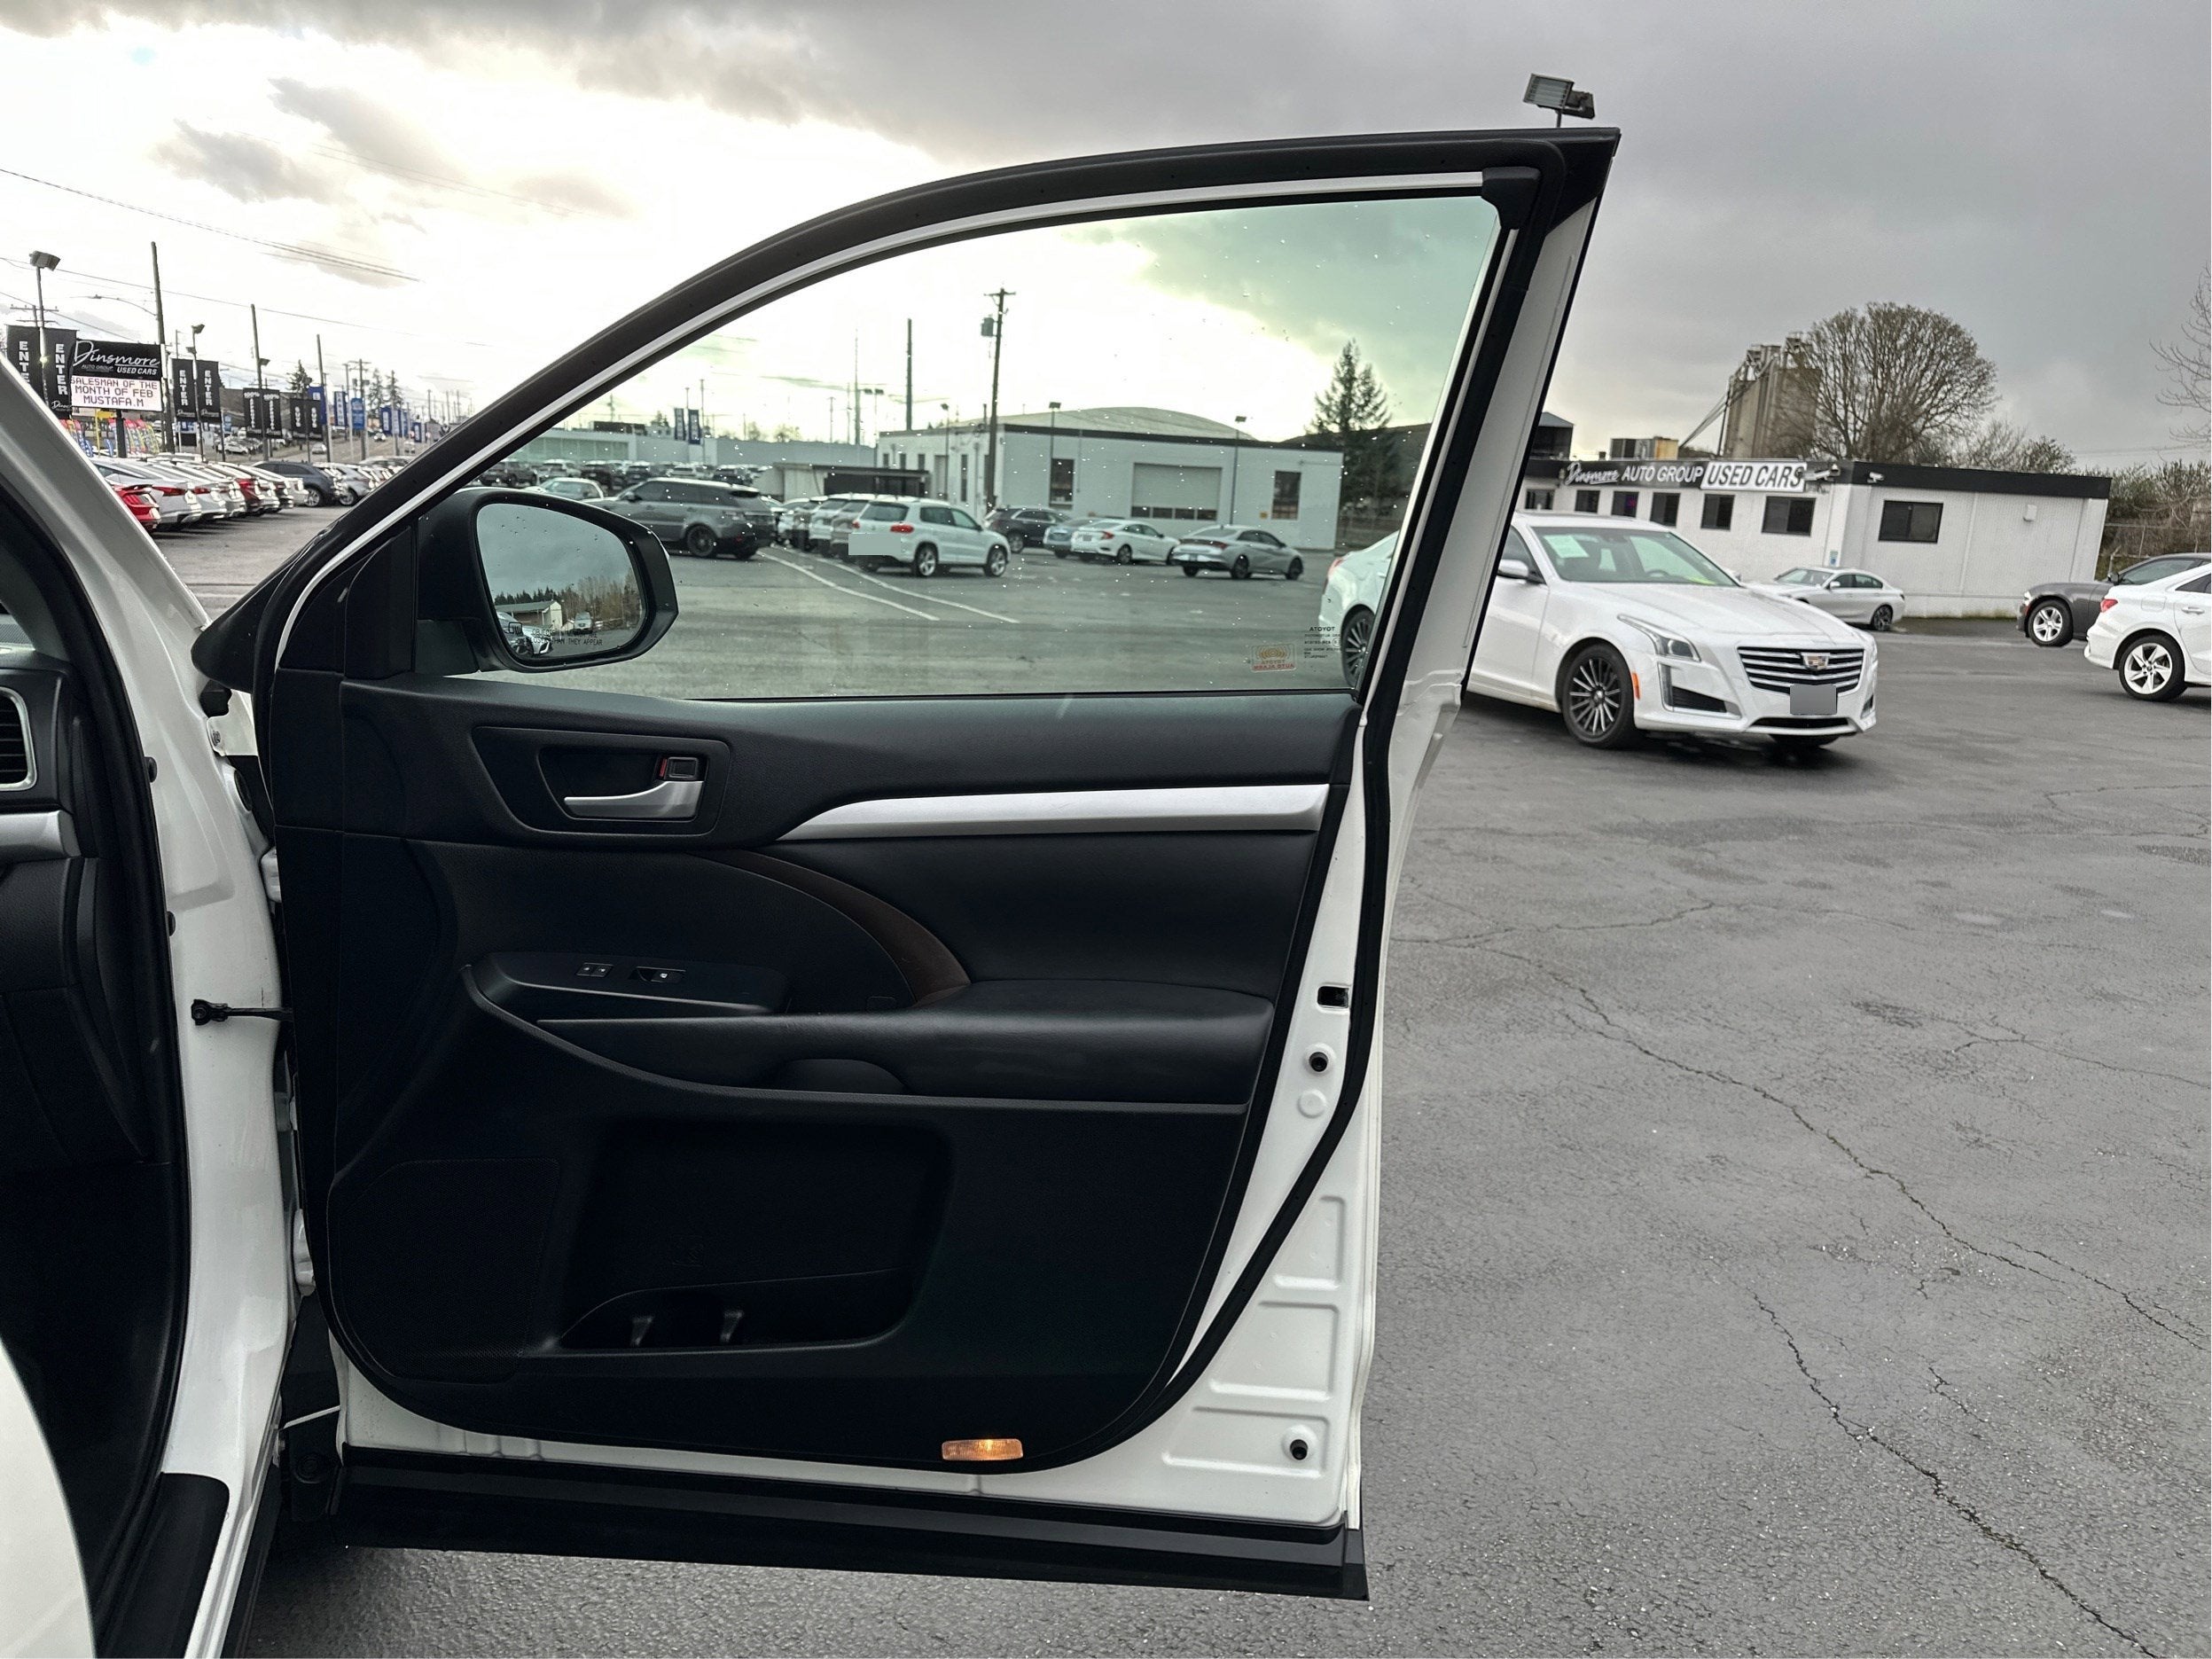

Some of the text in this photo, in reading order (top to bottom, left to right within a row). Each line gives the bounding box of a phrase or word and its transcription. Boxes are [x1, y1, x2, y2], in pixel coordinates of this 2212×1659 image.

[74, 340, 160, 366] Dinsmore
[55, 344, 68, 395] ENTER
[71, 378, 119, 387] SALESMAN
[74, 385, 111, 395] MONTH
[132, 388, 153, 397] FEB
[179, 370, 188, 405] ENTER
[204, 370, 213, 405] ENTER
[83, 395, 145, 407] MUSTAFA.M
[1621, 466, 1655, 482] AUTO
[1657, 466, 1704, 483] GROUP
[1708, 465, 1755, 486] USED
[1755, 466, 1804, 489] CARS
